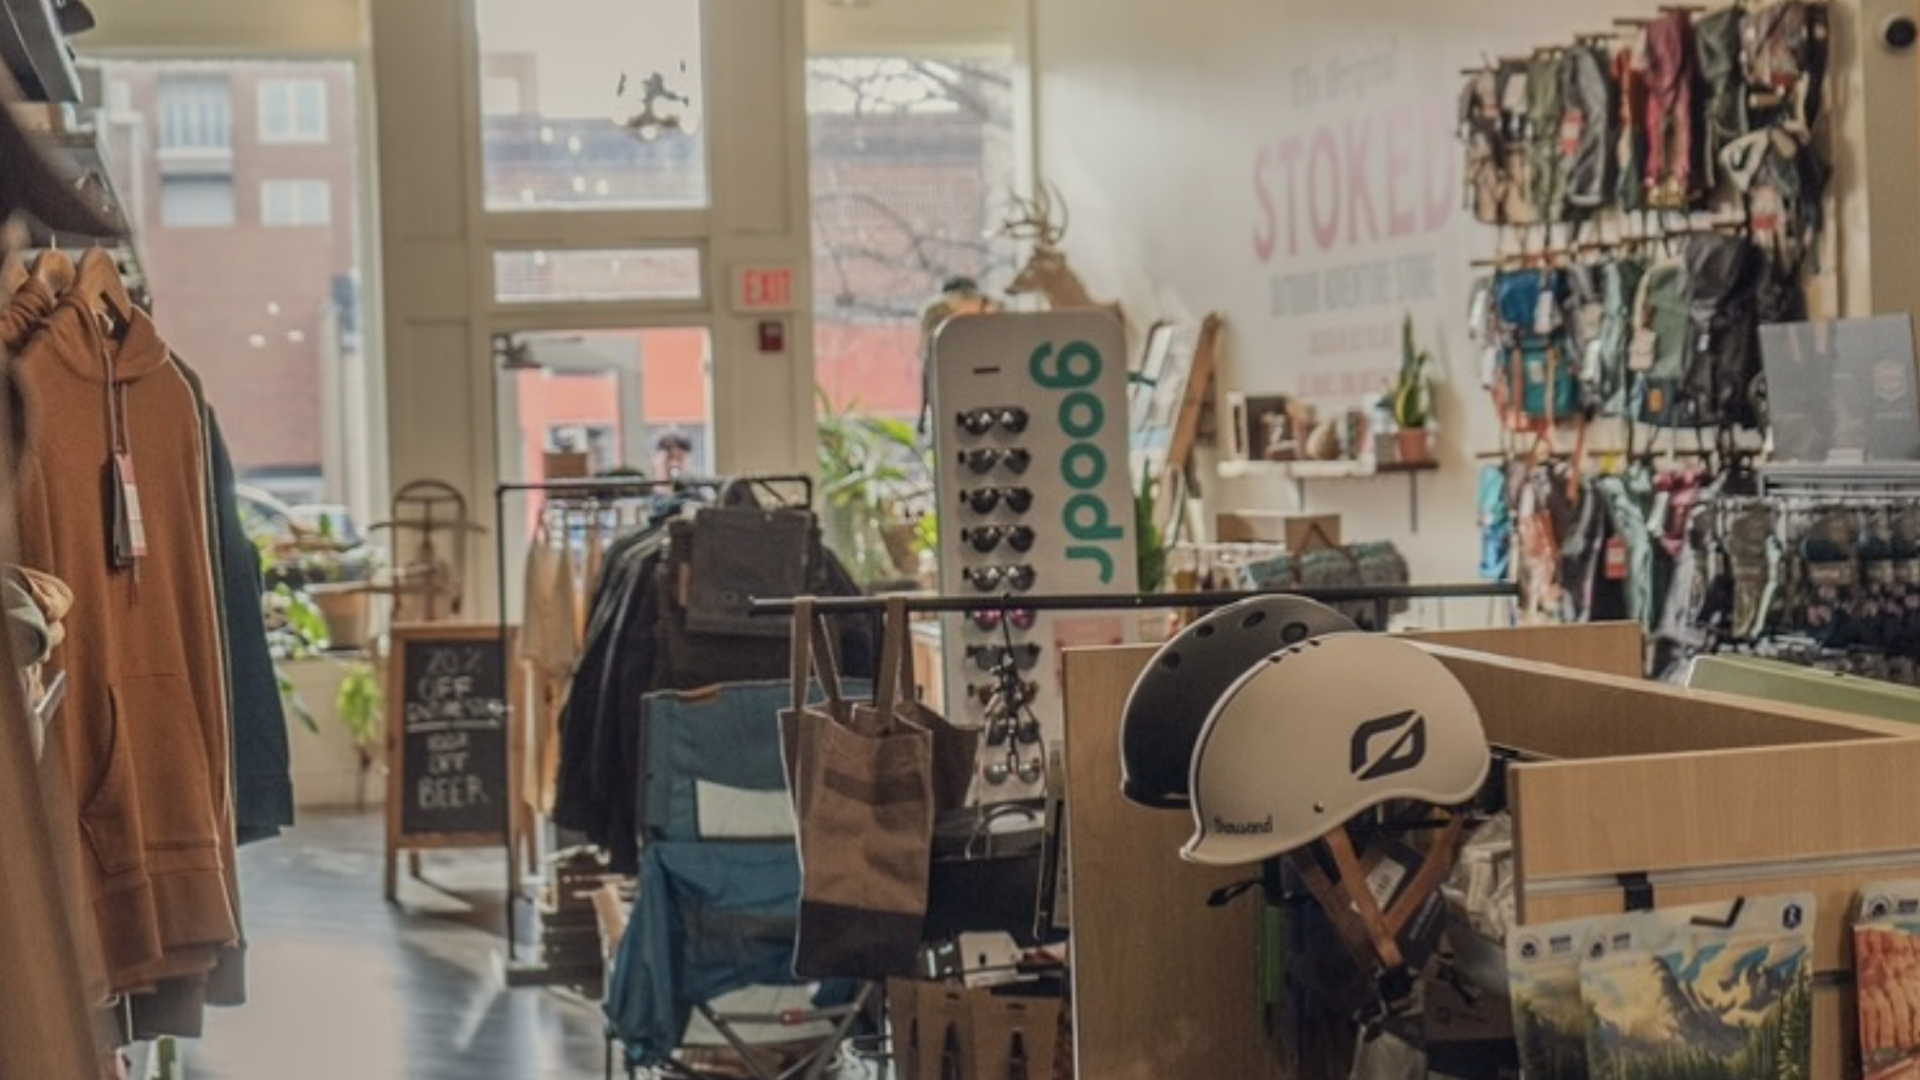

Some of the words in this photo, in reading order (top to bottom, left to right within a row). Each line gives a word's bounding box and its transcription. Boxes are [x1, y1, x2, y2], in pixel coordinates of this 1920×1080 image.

[1253, 102, 1457, 264] STOKED
[744, 268, 791, 307] EXIT
[1028, 340, 1124, 585] goodr
[417, 674, 474, 700] OFF
[416, 775, 491, 810] BEER
